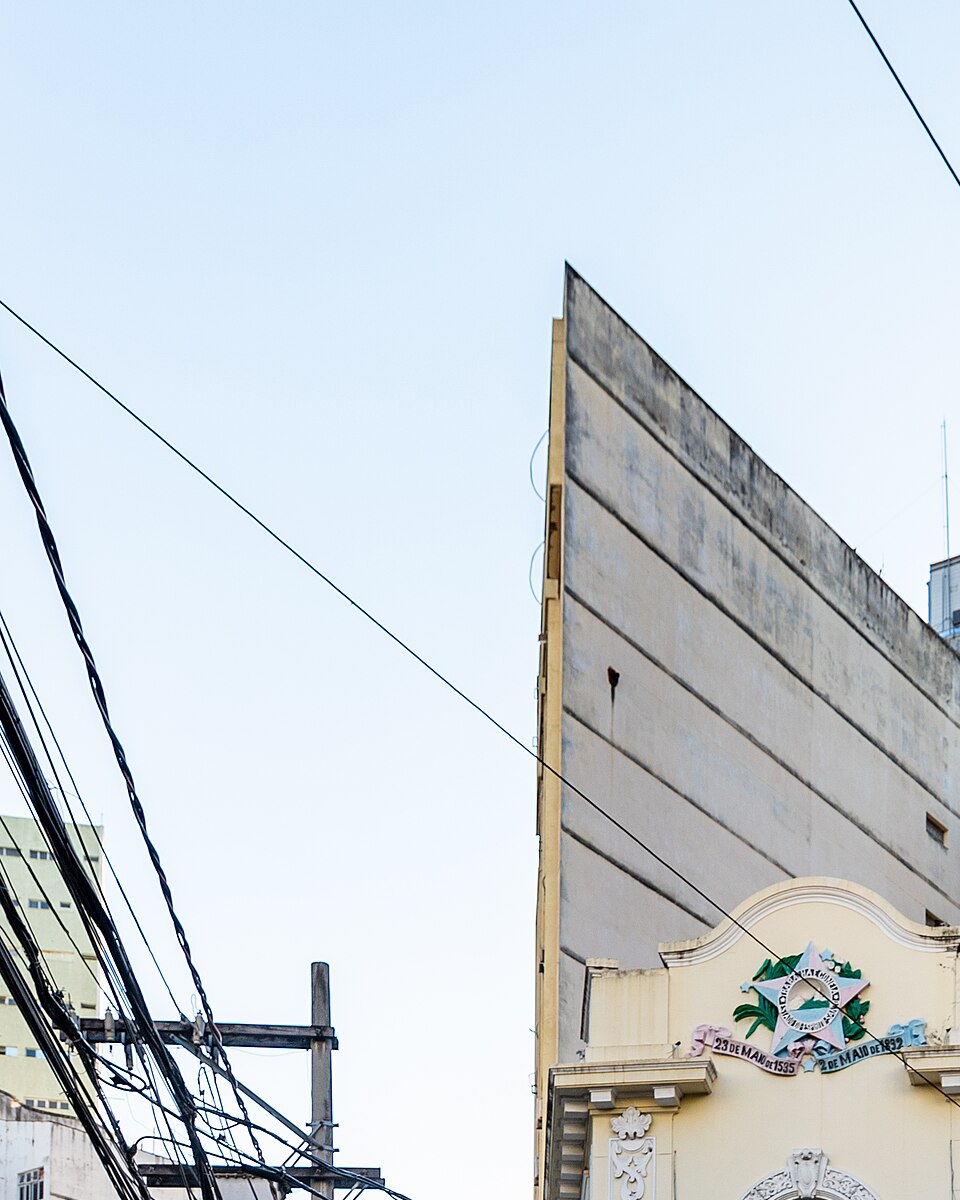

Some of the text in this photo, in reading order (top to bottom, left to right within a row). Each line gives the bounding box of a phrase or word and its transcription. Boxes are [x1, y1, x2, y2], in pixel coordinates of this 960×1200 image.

[714, 1037, 796, 1074] 23 DE MAIO DE 1535
[818, 1058, 827, 1071] 2
[828, 1058, 839, 1070] DE
[839, 1045, 869, 1067] MAIO
[870, 1045, 880, 1055] DE
